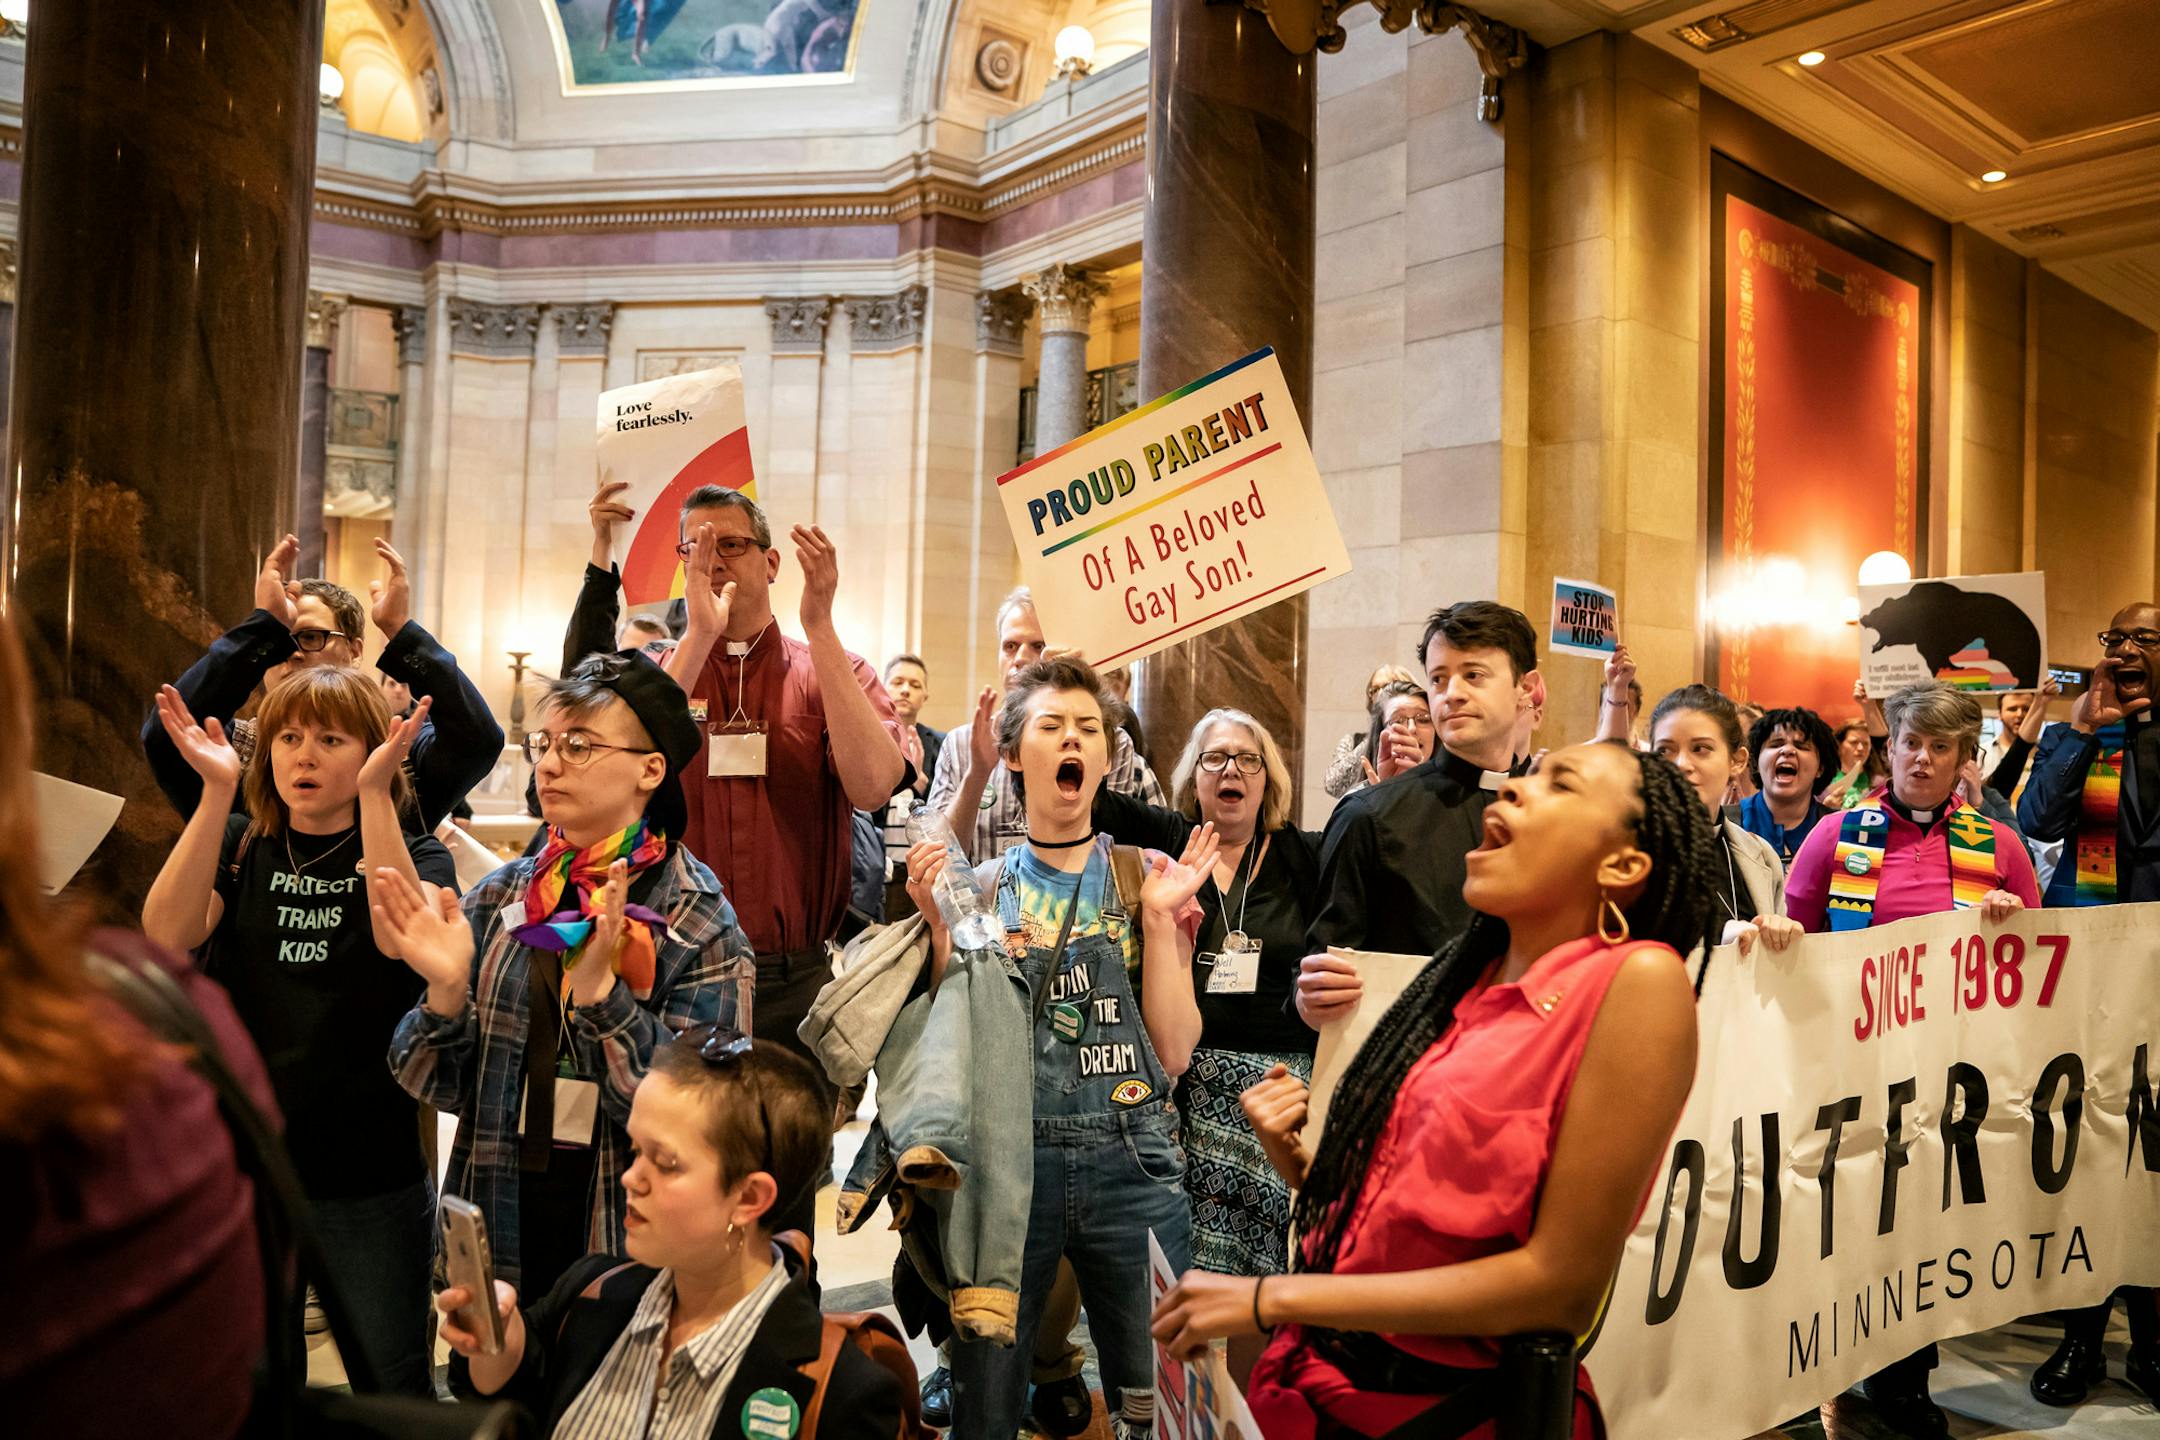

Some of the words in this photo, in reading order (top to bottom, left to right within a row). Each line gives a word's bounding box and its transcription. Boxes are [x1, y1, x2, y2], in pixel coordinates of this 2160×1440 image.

[616, 401, 652, 416] Love
[616, 409, 693, 432] fearlessly.
[1027, 458, 1136, 536] PROUD
[1142, 392, 1269, 482] PARENT
[1082, 545, 1115, 591] Of
[1125, 536, 1145, 575] A
[1150, 480, 1266, 562] Beloved
[1124, 583, 1178, 625] Gay
[1185, 540, 1253, 601] Son!
[1573, 591, 1604, 611] STOP
[1560, 606, 1614, 632] HURTING
[1571, 626, 1604, 647] KIDS
[277, 905, 343, 930] TRANS
[278, 939, 329, 962] KIDS
[1854, 943, 1927, 1042] SINCE
[1950, 934, 2071, 1016] 1987
[1094, 998, 1120, 1023] THE
[1080, 1044, 1136, 1075] DREAM
[1788, 1226, 2094, 1378] MINNESOTA
